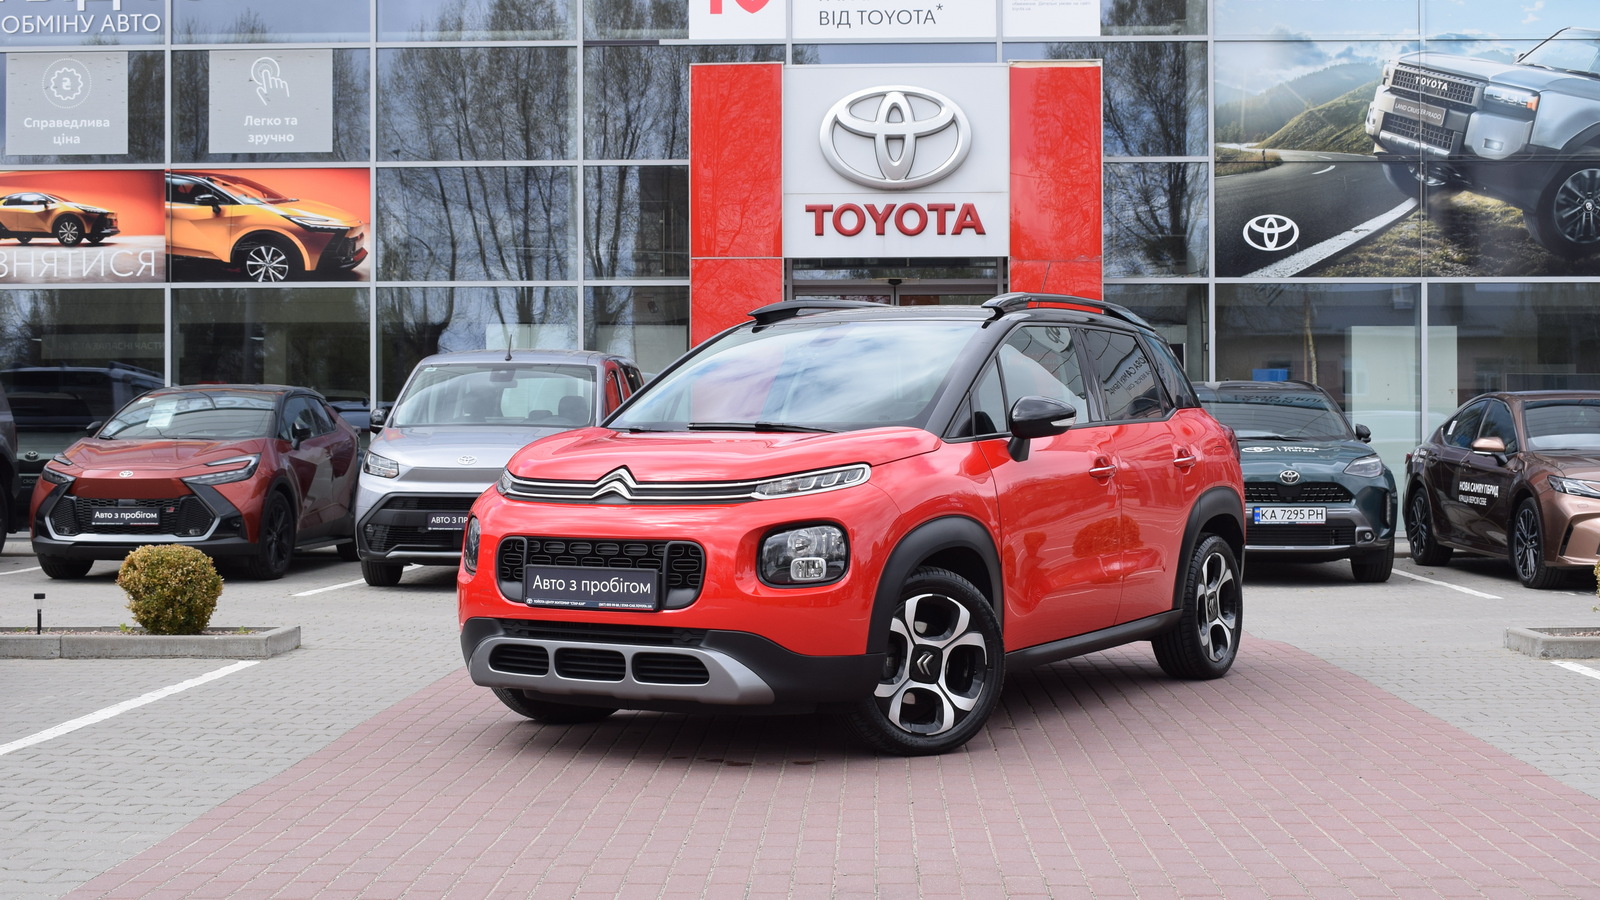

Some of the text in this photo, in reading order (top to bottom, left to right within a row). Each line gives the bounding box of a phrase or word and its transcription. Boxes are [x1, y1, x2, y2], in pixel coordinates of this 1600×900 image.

[1, 13, 161, 34] ОБМІНУ АВТО
[819, 10, 851, 29] ВІД
[1415, 76, 1448, 91] TOYOTA
[1395, 102, 1441, 120] LAND CRUISER PRADO
[24, 117, 110, 129] Справедлива
[244, 115, 298, 127] Легко та
[53, 133, 81, 145] ціна
[247, 132, 295, 144] зручно
[805, 203, 986, 237] TOYOTA
[94, 511, 113, 519] Авто
[120, 510, 157, 520] пробігом
[431, 516, 450, 524] АВТО
[1261, 509, 1324, 520] KA 7295 PH
[532, 575, 651, 595] Авто з пробігом
